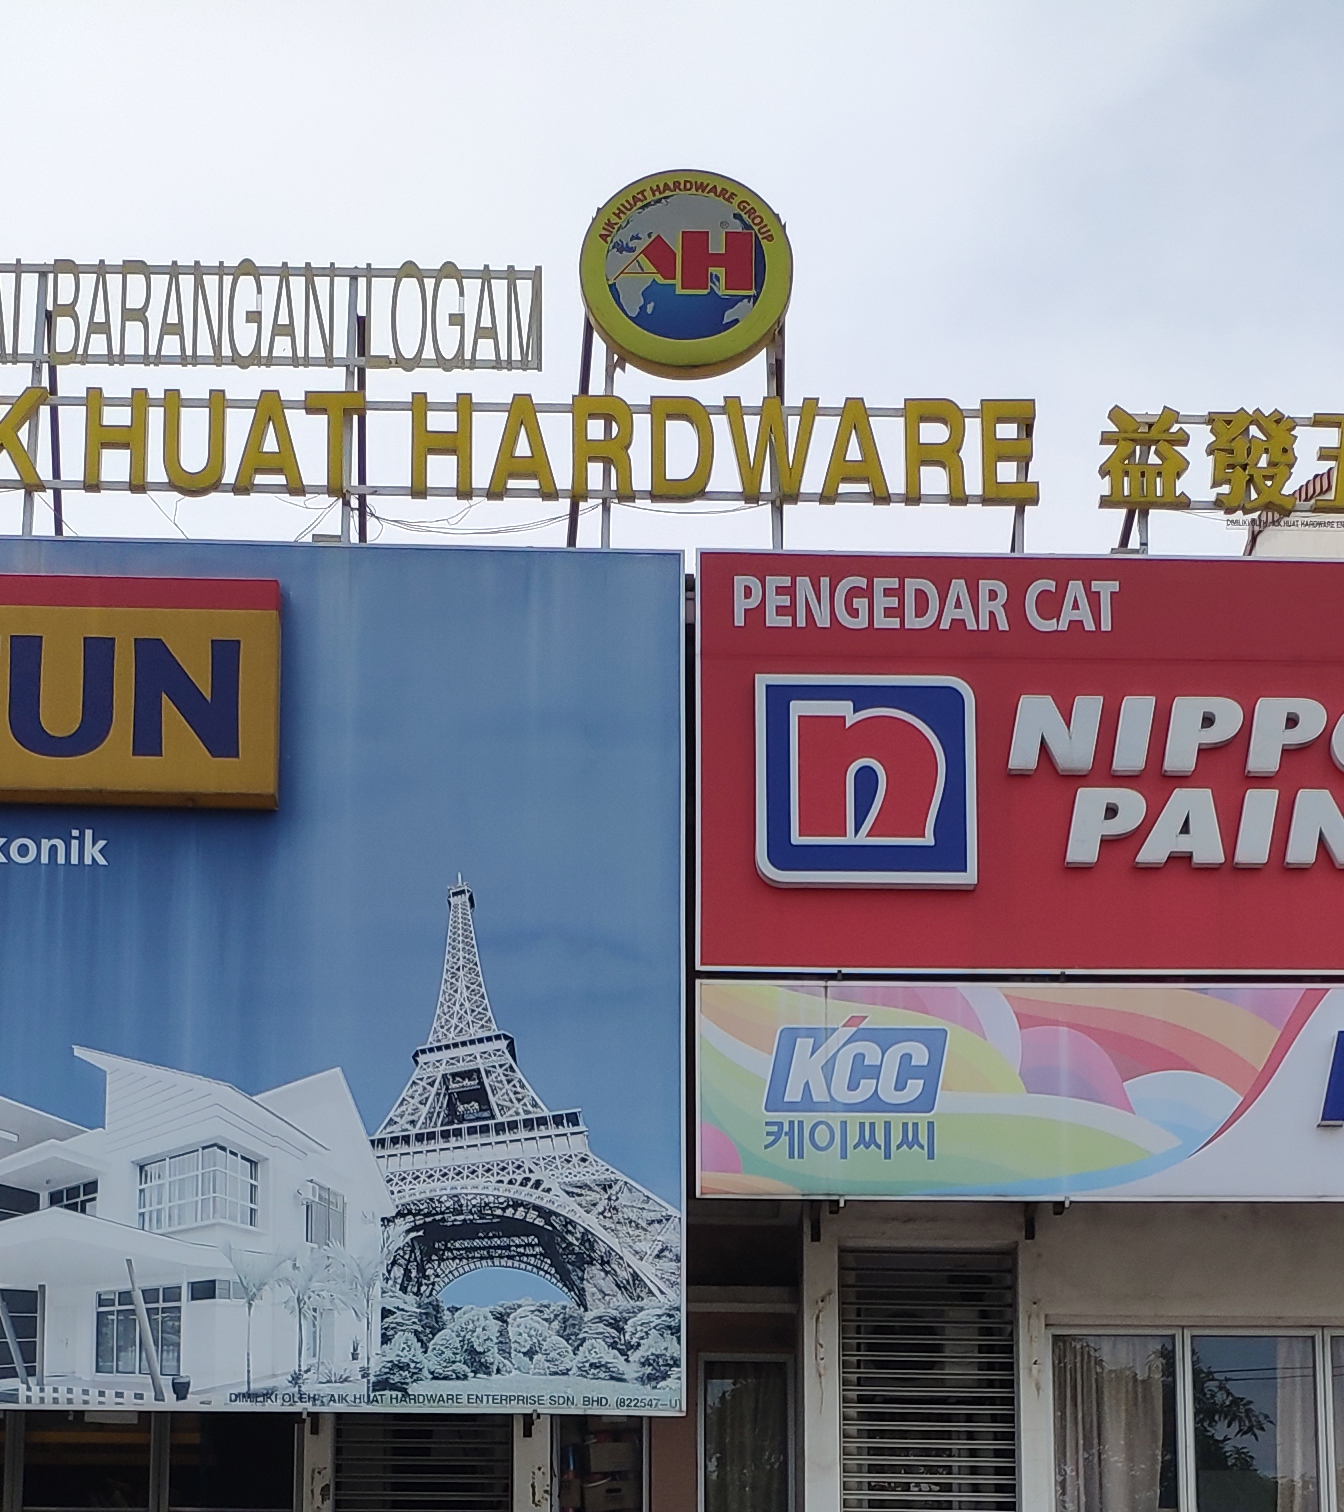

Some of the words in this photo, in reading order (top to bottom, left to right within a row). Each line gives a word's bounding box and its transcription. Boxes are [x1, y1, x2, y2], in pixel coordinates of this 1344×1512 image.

[598, 217, 617, 244] AIK
[612, 189, 647, 220] HUAT
[649, 179, 737, 204] HARDWARE
[736, 199, 775, 243] GROUP
[49, 259, 335, 369] BARANGAN
[363, 261, 542, 371] LOGAM
[84, 387, 366, 497] HUAT
[411, 392, 1039, 506] HARDWARE
[732, 574, 1009, 632] PENGEDAR
[1023, 578, 1120, 633] CAT
[783, 1016, 930, 1104] KCC
[764, 1120, 936, 1161] 케이씨씨
[327, 1392, 350, 1406] AIK
[353, 1392, 386, 1406] HUAT
[388, 1392, 464, 1406] HARDWARE
[467, 1393, 545, 1407] ENTERPRISE
[548, 1394, 579, 1408] SDN.
[582, 1395, 612, 1408] BHD.
